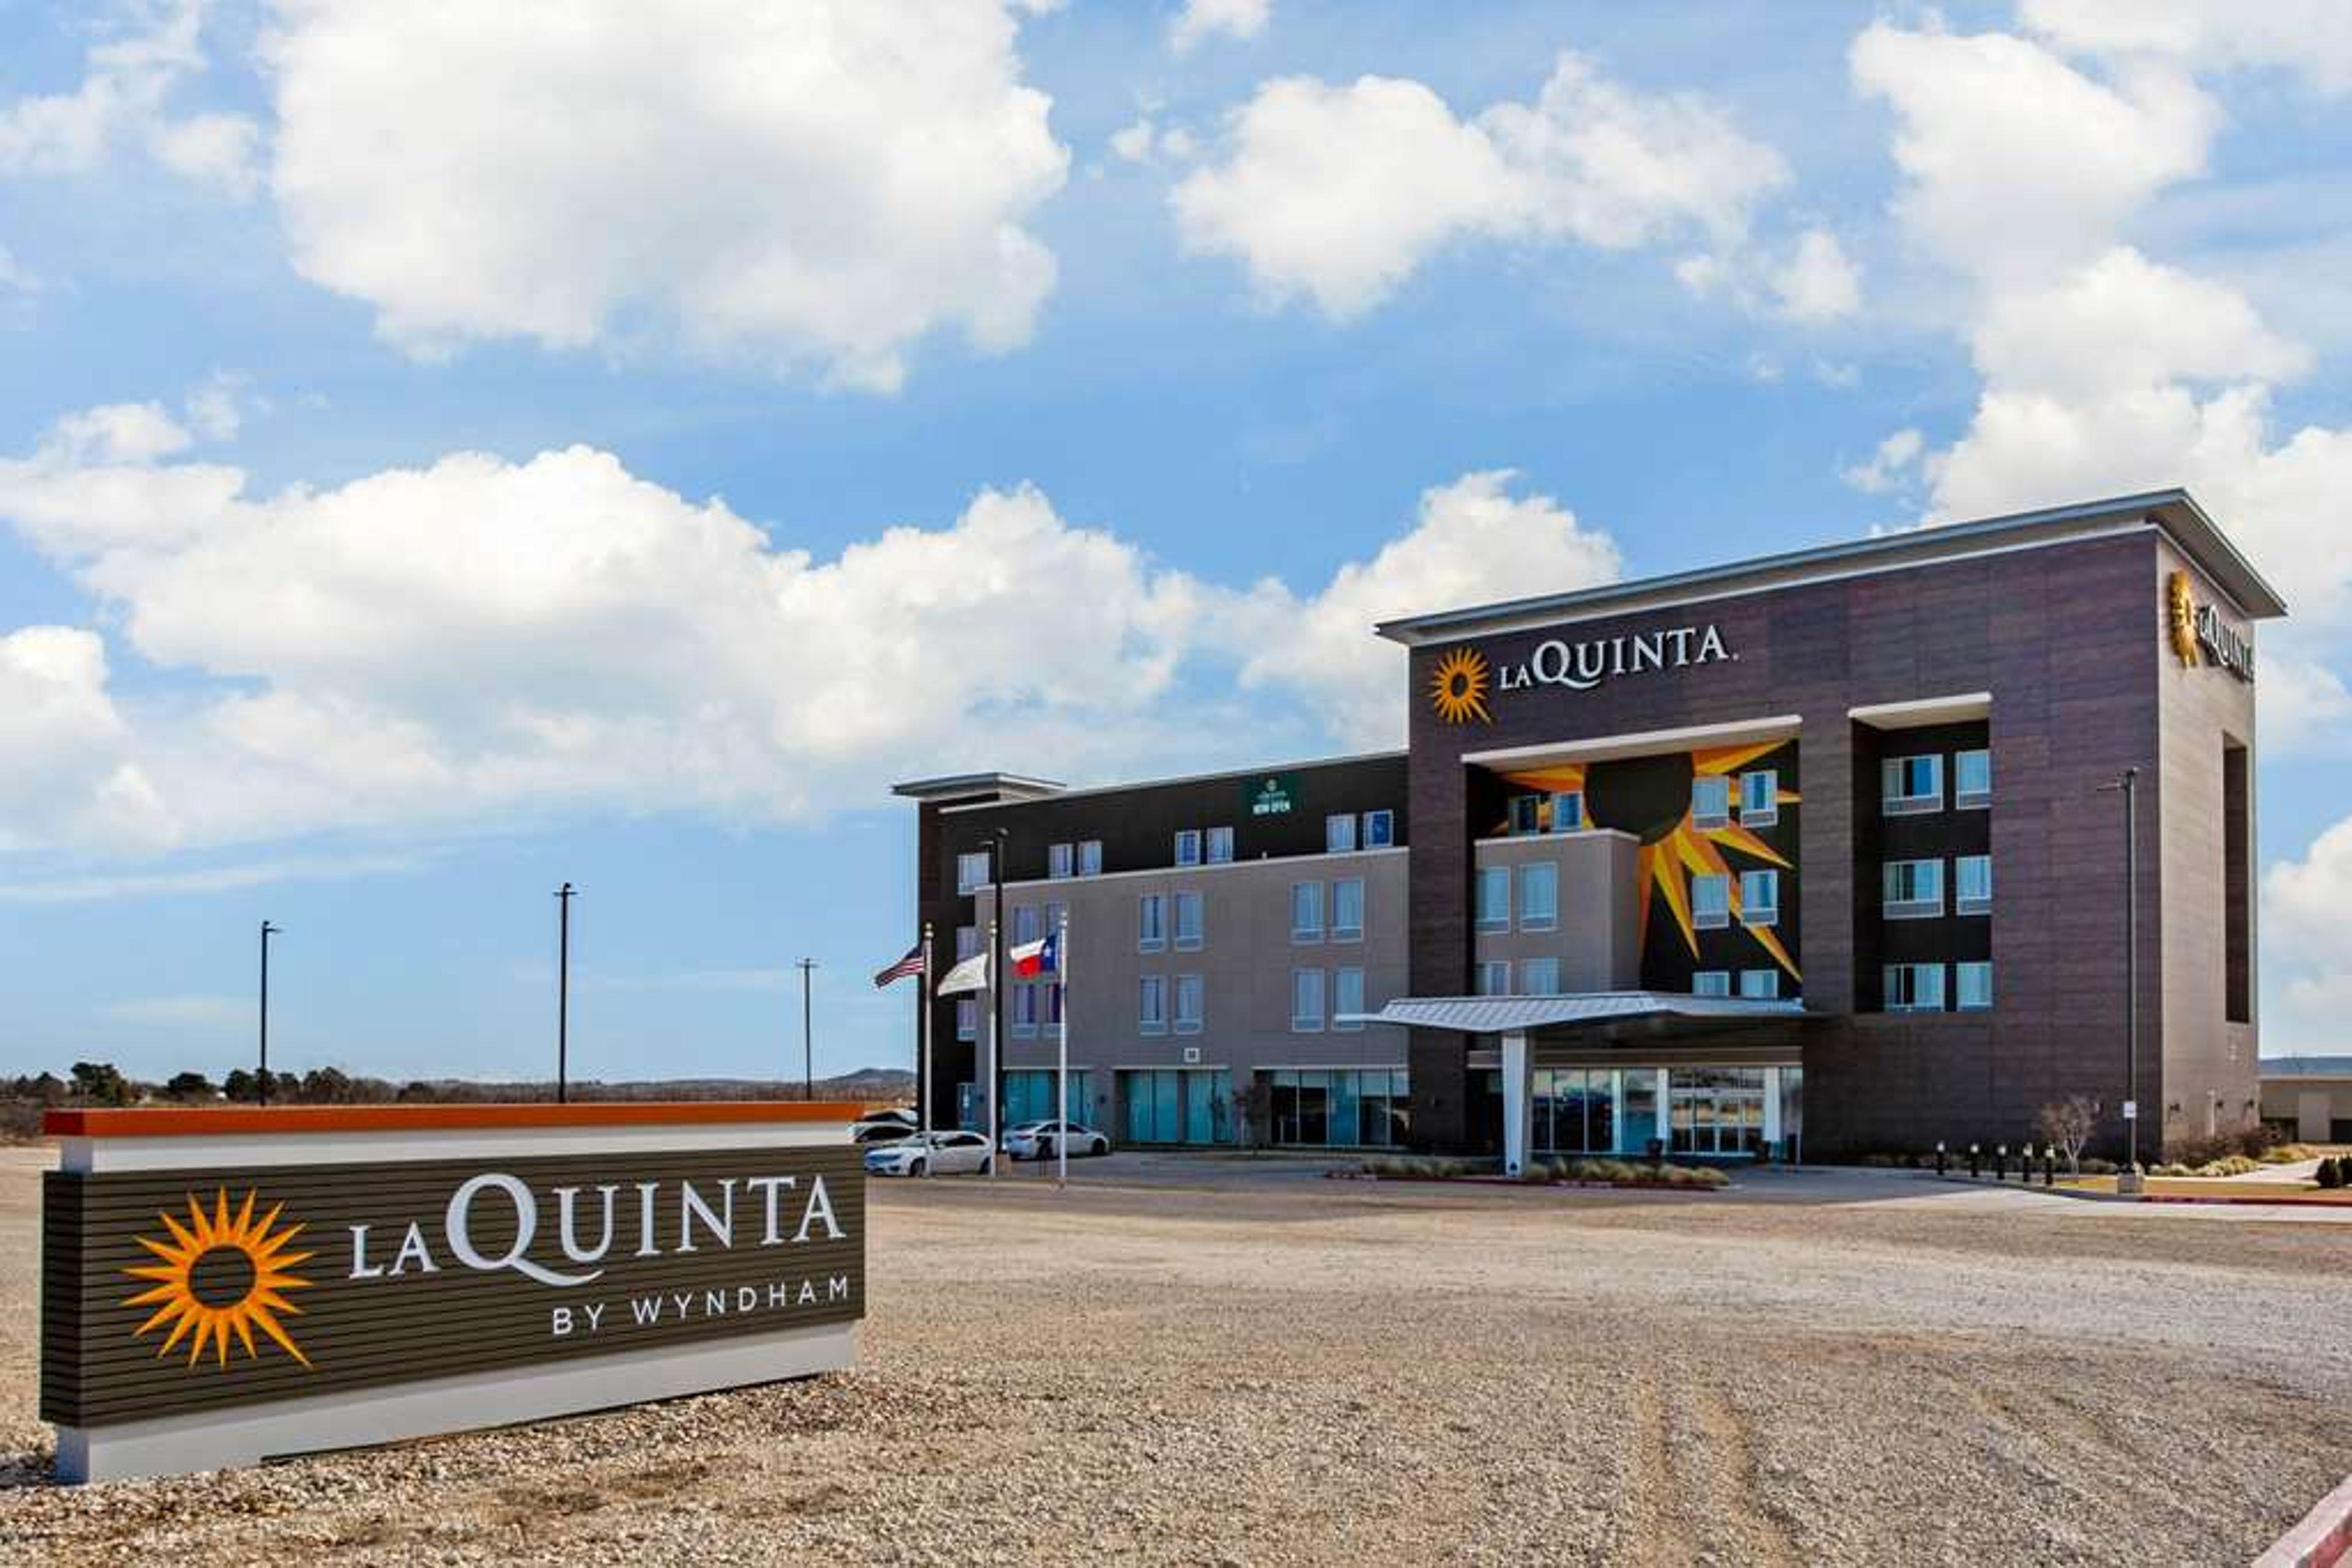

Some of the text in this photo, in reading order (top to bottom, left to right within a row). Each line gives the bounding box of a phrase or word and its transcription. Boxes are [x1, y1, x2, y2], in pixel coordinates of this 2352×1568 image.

[1501, 625, 1728, 689] LA QUINTA
[349, 1174, 847, 1287] LA QUINTA
[553, 1276, 848, 1335] BY WYNDHAM
